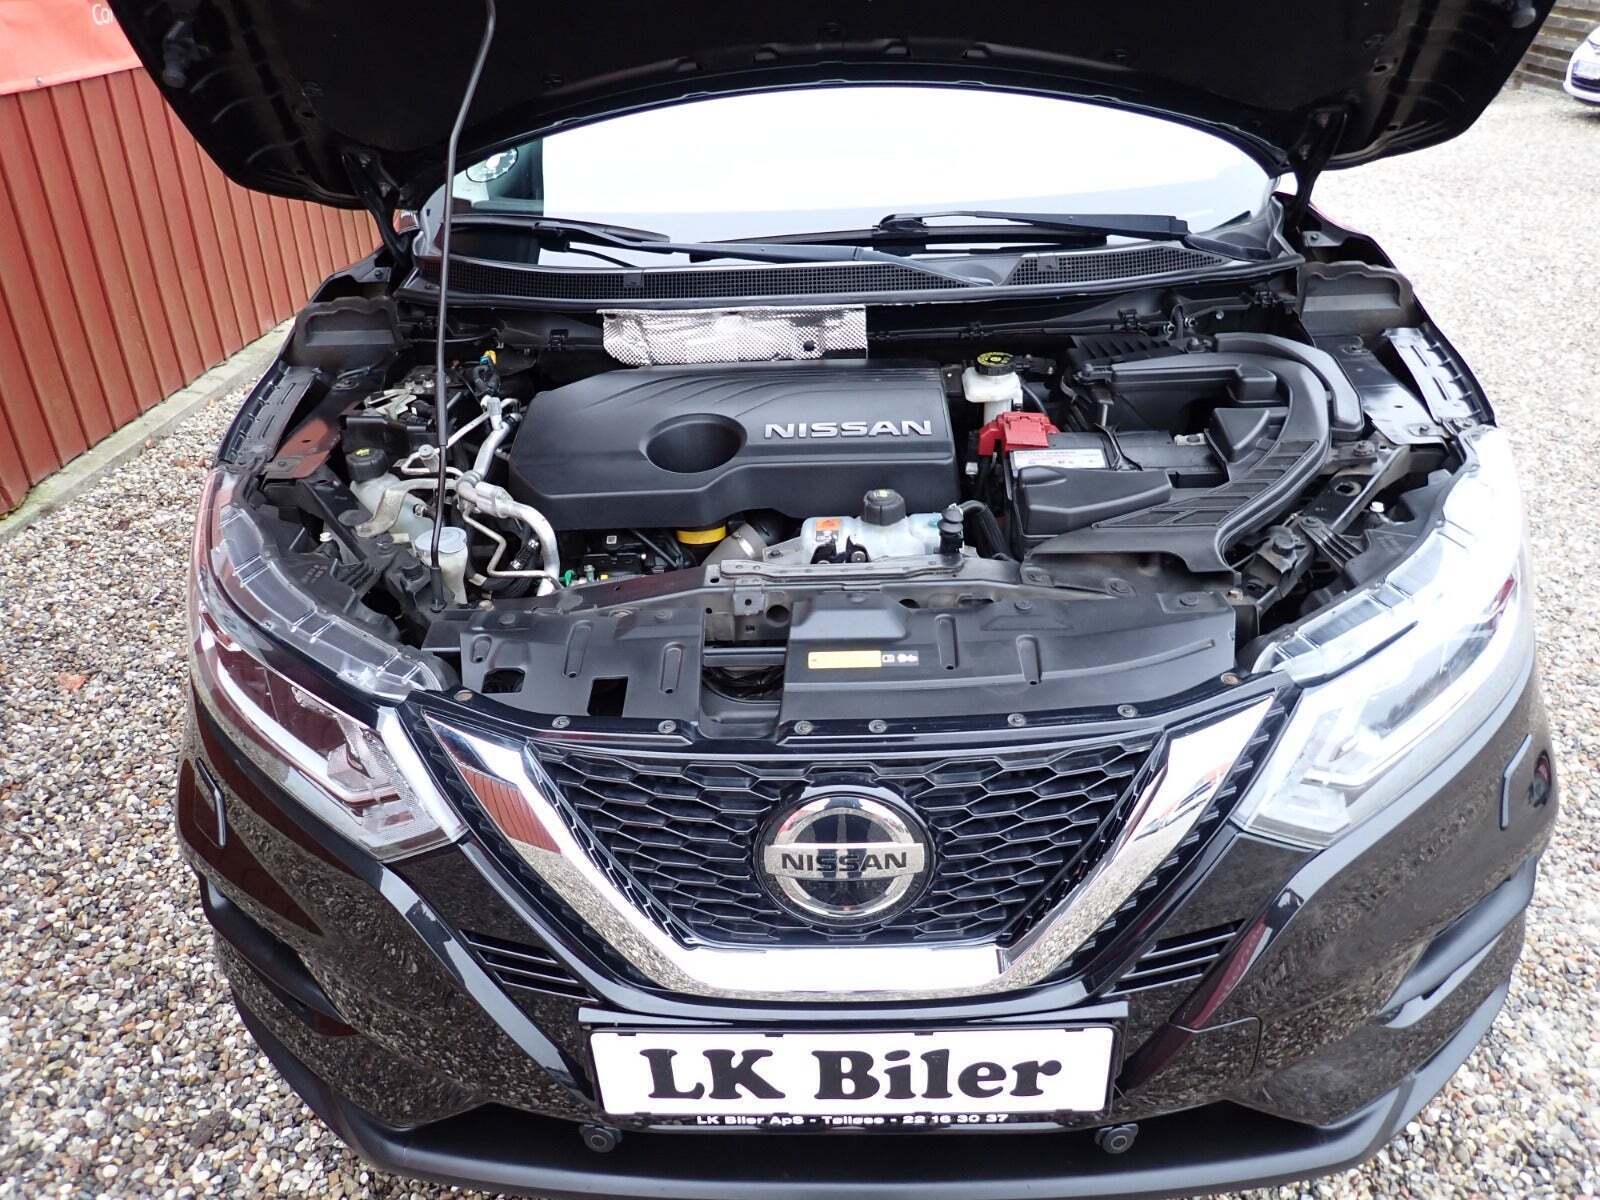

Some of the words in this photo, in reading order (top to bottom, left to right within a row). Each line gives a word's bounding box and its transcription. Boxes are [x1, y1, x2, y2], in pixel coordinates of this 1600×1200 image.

[764, 420, 932, 439] NISSAN
[781, 852, 907, 873] NISSAN
[639, 1048, 786, 1100] LK
[811, 1048, 1062, 1100] Biler
[696, 1115, 720, 1125] LK
[724, 1115, 765, 1125] Biler
[769, 1115, 805, 1126] ApS
[902, 1115, 926, 1124] 22
